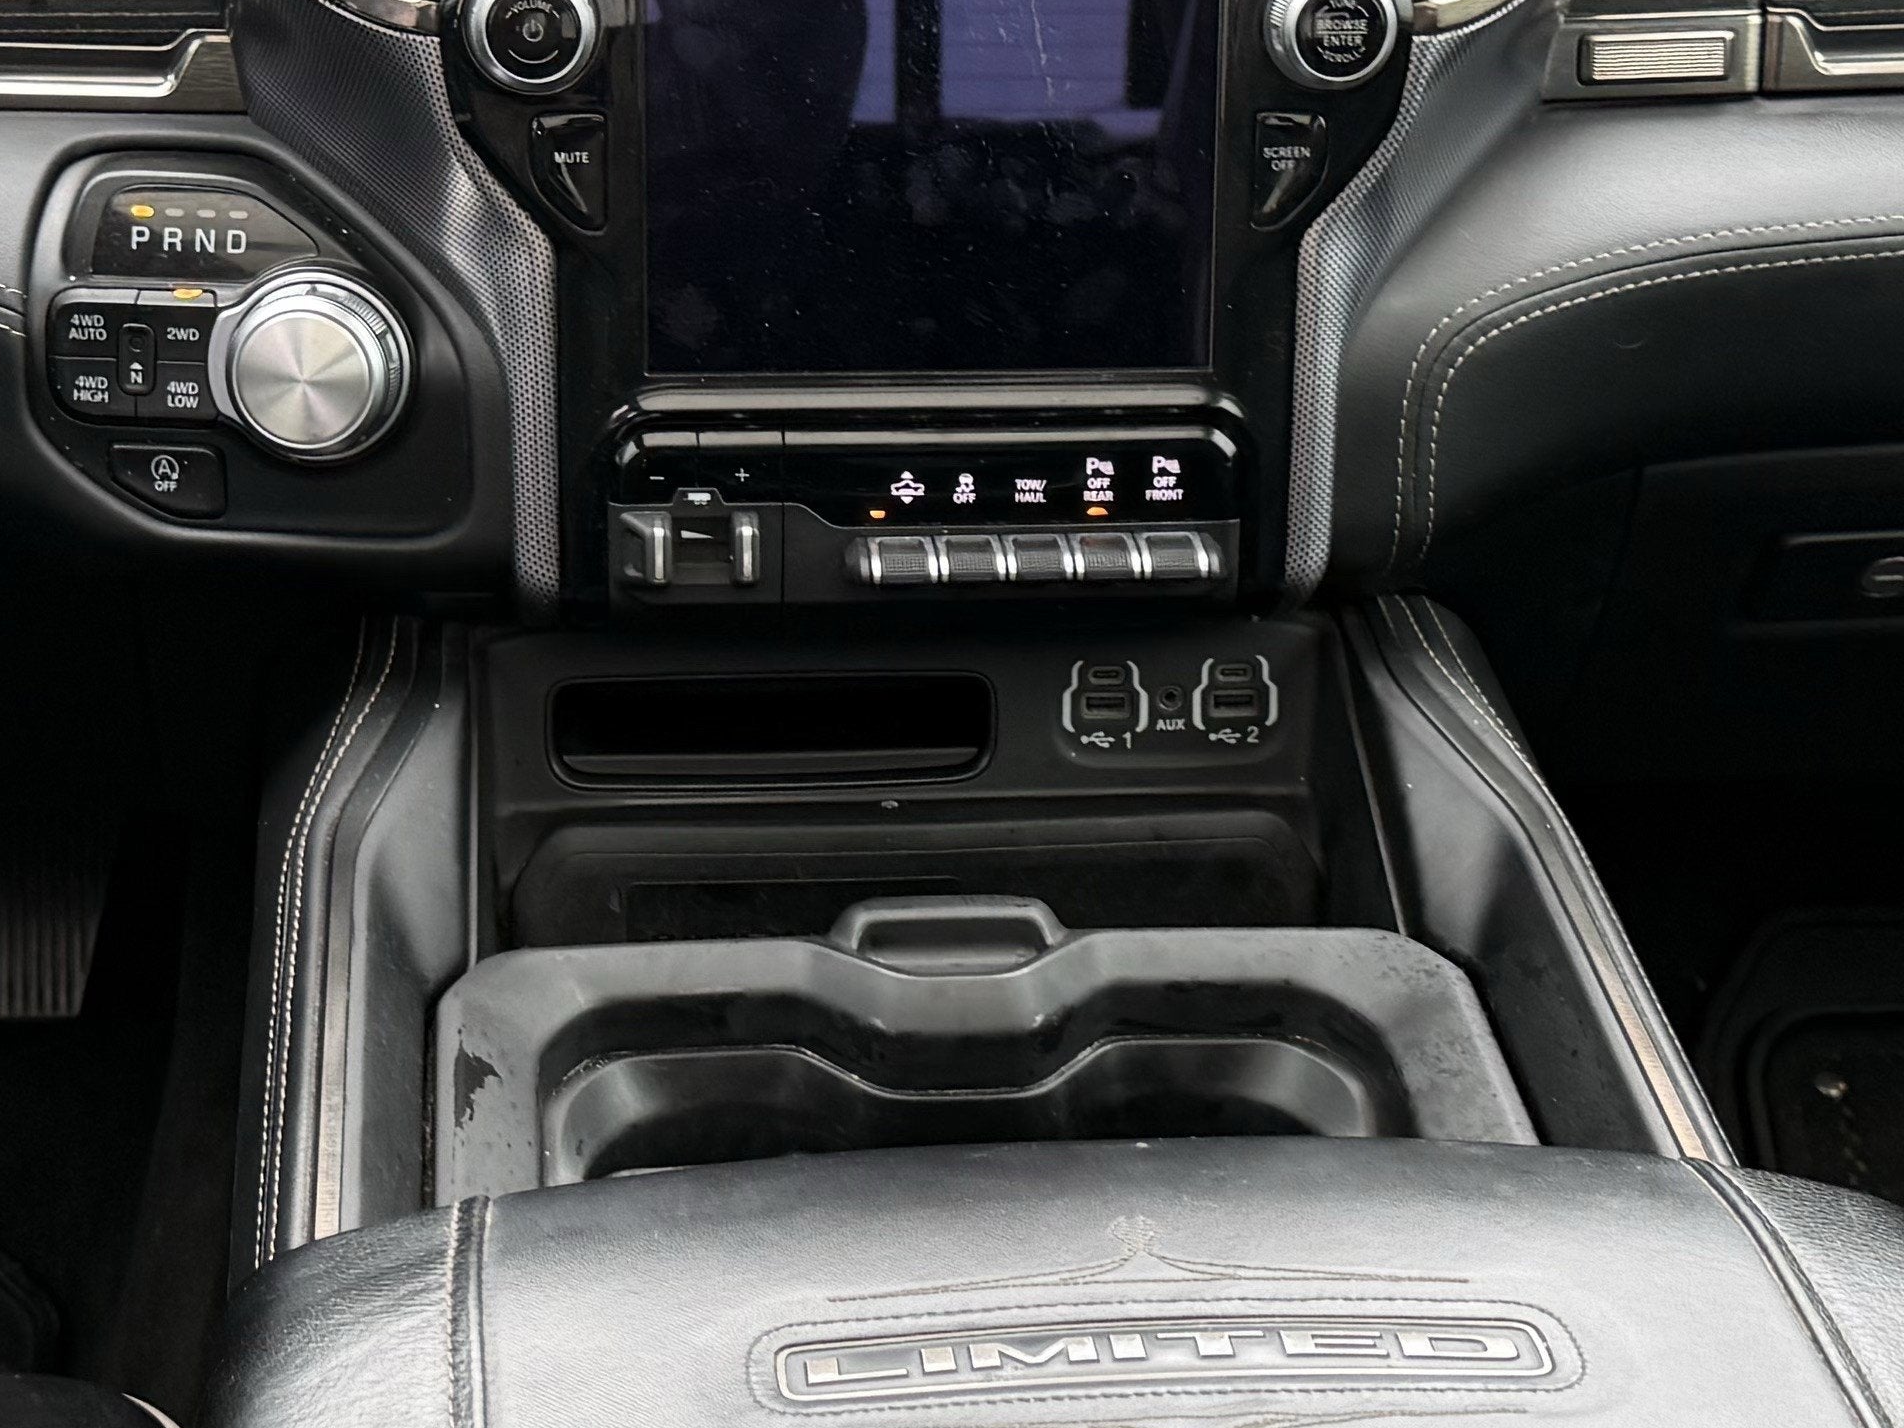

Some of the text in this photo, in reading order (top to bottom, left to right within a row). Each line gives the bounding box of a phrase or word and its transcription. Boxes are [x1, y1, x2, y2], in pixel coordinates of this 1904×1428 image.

[511, 0, 554, 15] VOLUME
[1316, 19, 1368, 30] BROWSE
[1323, 34, 1363, 47] ENTER
[554, 151, 590, 164] MUTE
[1263, 146, 1311, 159] SCREEN
[1271, 159, 1296, 172] OFF
[131, 226, 247, 254] P R N D
[70, 314, 105, 328] 4WD
[68, 328, 107, 341] AUTO
[166, 328, 200, 341] 2WD
[74, 376, 108, 390] 4WD
[130, 371, 143, 385] N
[166, 381, 199, 395] 4WD
[73, 389, 109, 404] HIGH
[166, 395, 199, 409] LOW
[154, 480, 178, 492] OFF
[1014, 478, 1048, 491] TOW/
[1087, 477, 1111, 490] OFF
[1153, 476, 1177, 488] OFF
[952, 493, 976, 504] OFF
[1014, 492, 1047, 503] HAUL
[1083, 490, 1114, 502] REAR
[1145, 489, 1184, 502] FRONT
[1156, 718, 1186, 731] AUX
[1122, 732, 1132, 749] 1
[1246, 726, 1260, 743] 2
[802, 1328, 1521, 1386] LIMITED
